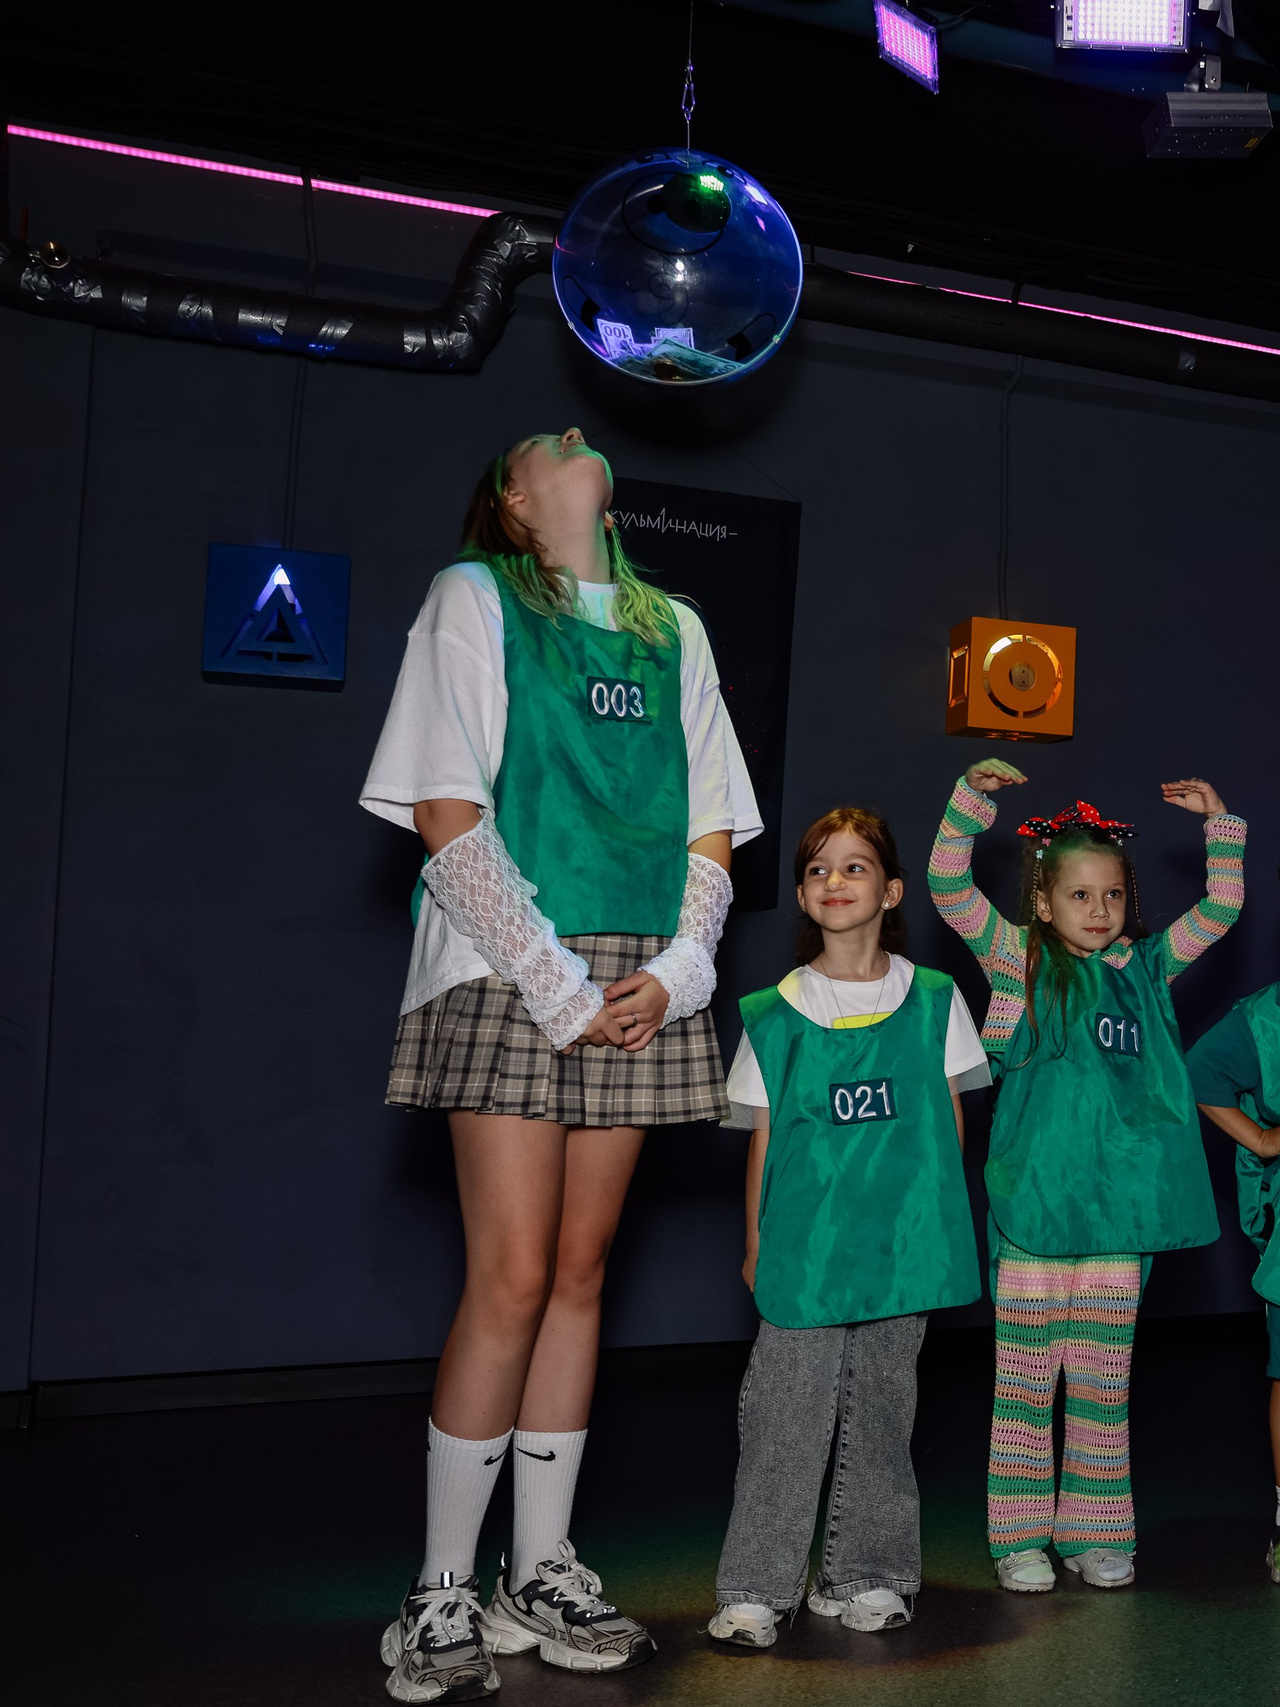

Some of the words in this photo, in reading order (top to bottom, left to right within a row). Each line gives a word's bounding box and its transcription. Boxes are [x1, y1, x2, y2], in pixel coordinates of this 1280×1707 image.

[591, 682, 645, 718] 003
[1098, 1017, 1139, 1052] 011
[834, 1081, 892, 1121] 021
